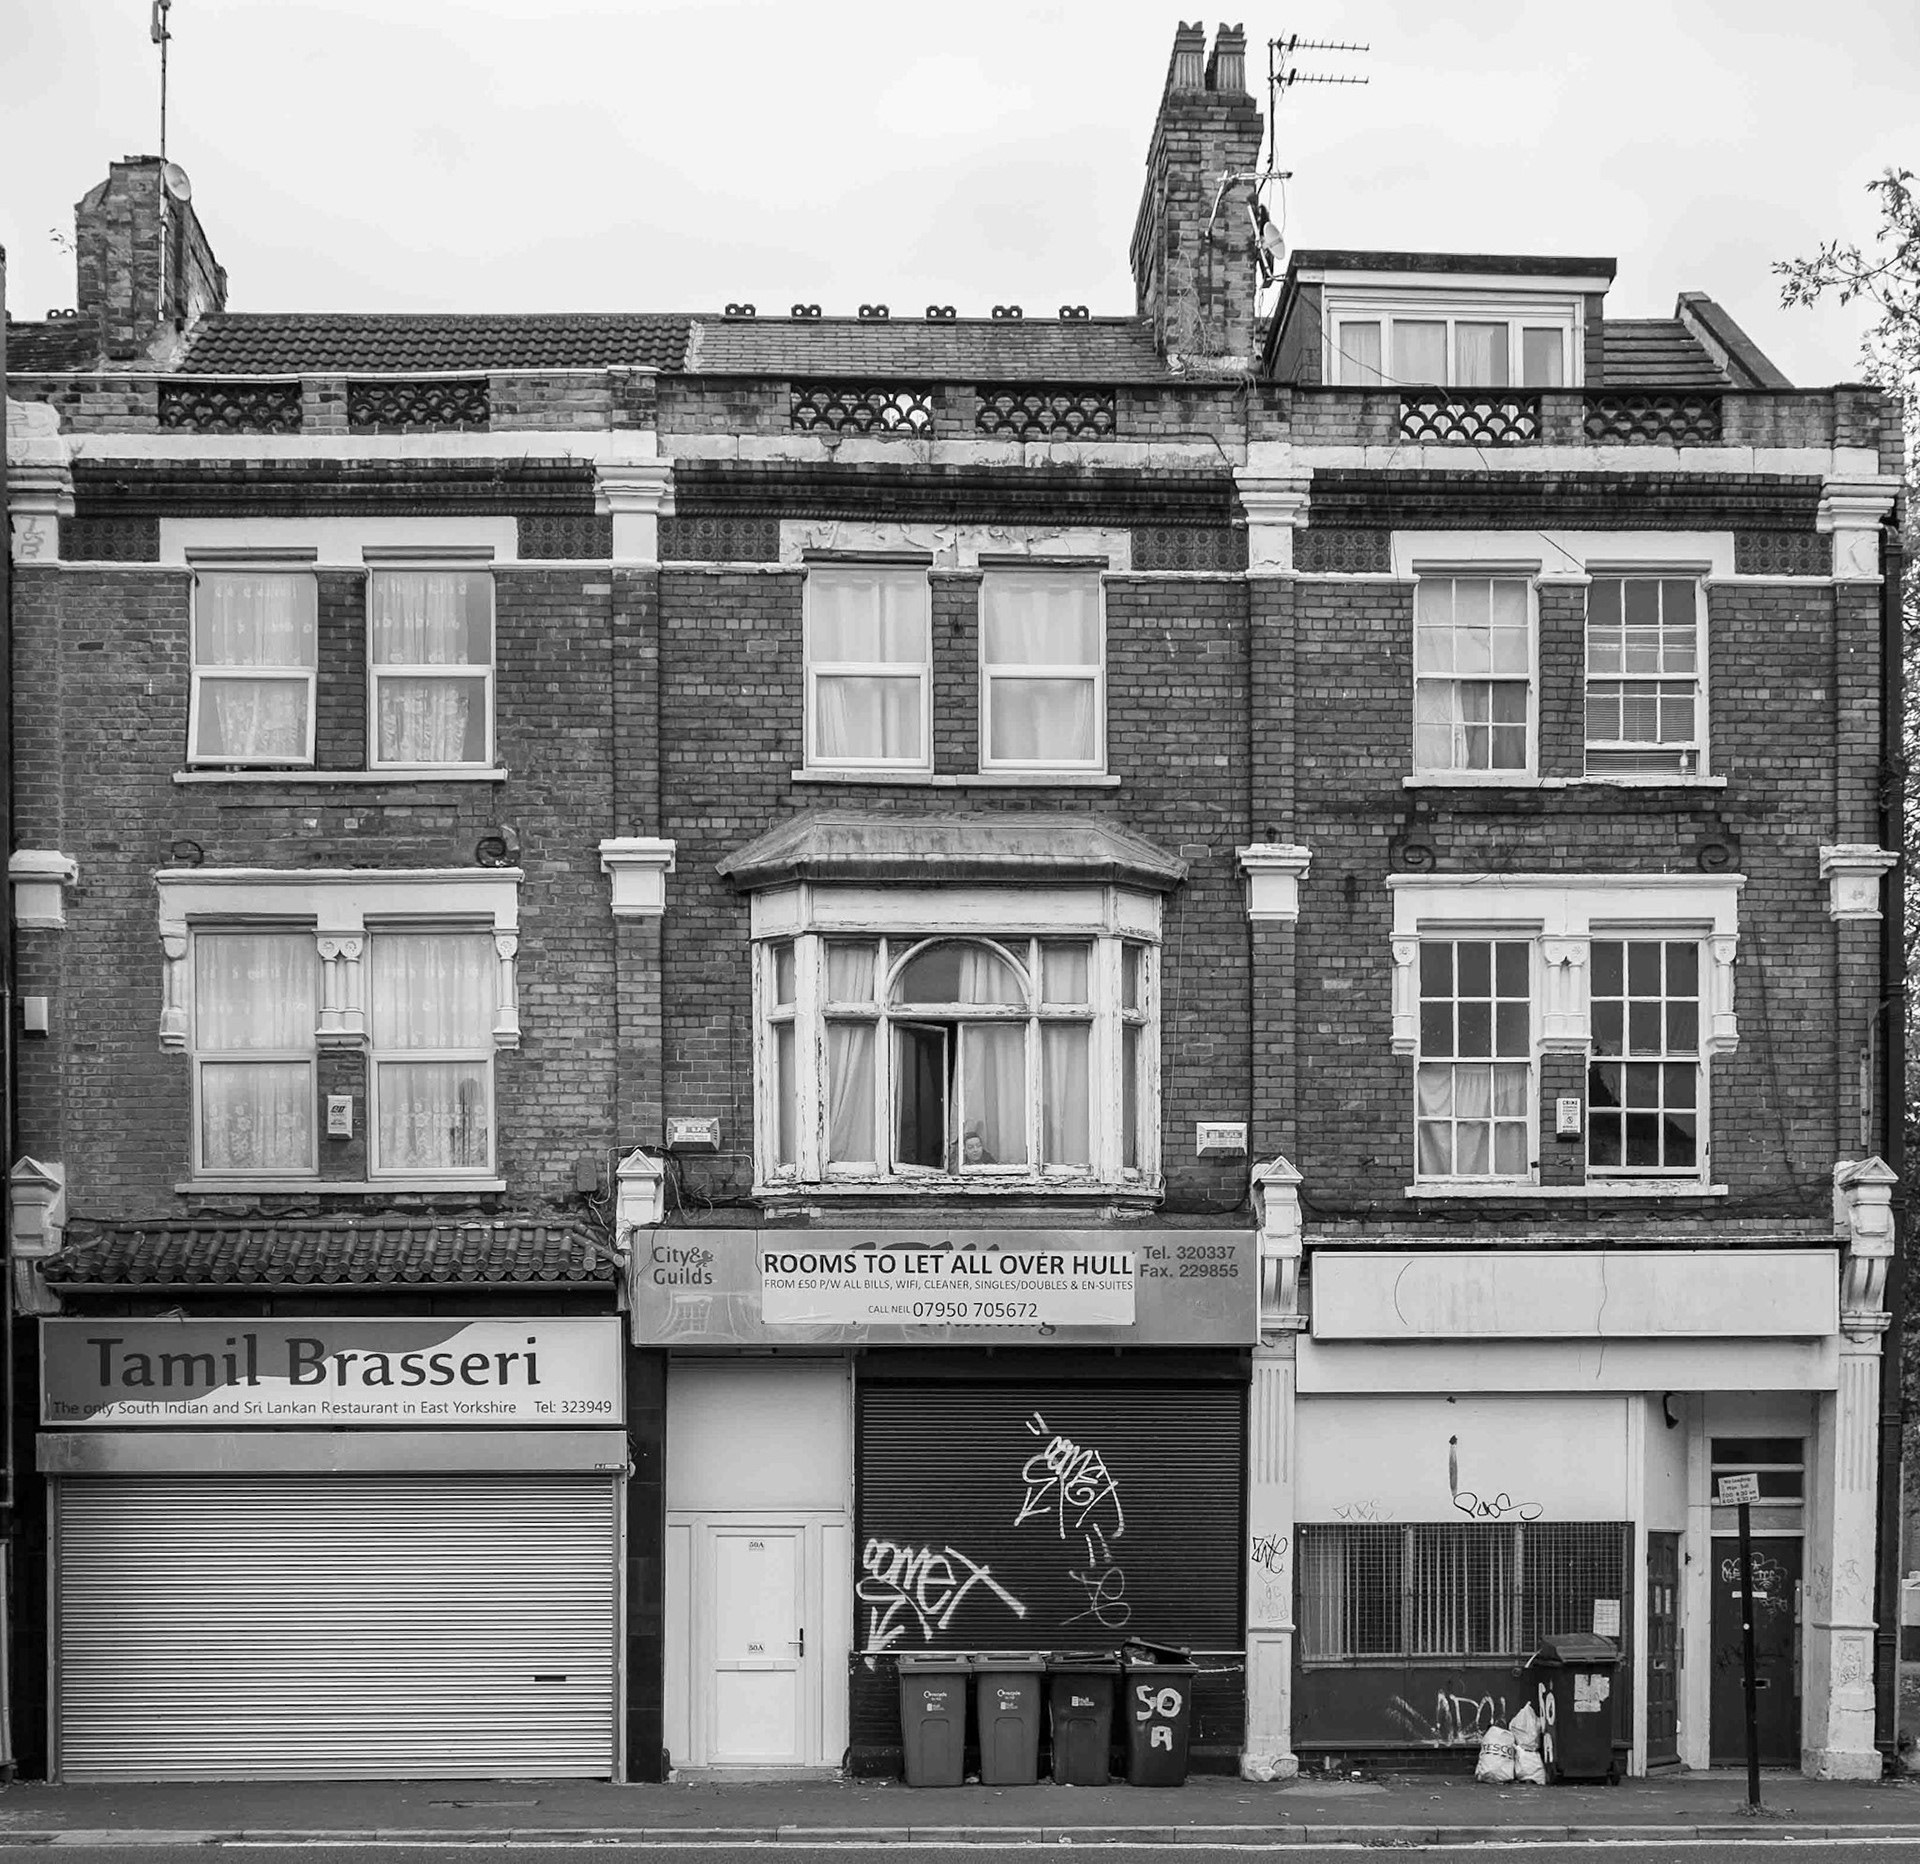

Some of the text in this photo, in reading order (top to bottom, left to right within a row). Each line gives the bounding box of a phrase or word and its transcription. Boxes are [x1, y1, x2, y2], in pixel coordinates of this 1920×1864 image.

[1143, 1245, 1236, 1260] Tel. 320337
[764, 1254, 1133, 1274] ROOMS TO LET ALL OVER HULL
[1140, 1264, 1239, 1278] Fax. 229855
[653, 1267, 713, 1285] Guilds
[764, 1279, 1133, 1291] FROM £50 P/W ALL BILLS, WIFI, CLEANER, SINGLES/DOUBLES & EN-SUITES
[868, 1302, 1038, 1318] CALL NEIL 07950 705672
[86, 1333, 541, 1387] Tamil Brasseri
[54, 1400, 612, 1417] The only South Indian and Sri Lankan Restaurant in East Yorkshire Tel: 323949
[1150, 1725, 1173, 1751] A
[1482, 1742, 1516, 1757] TESCO
